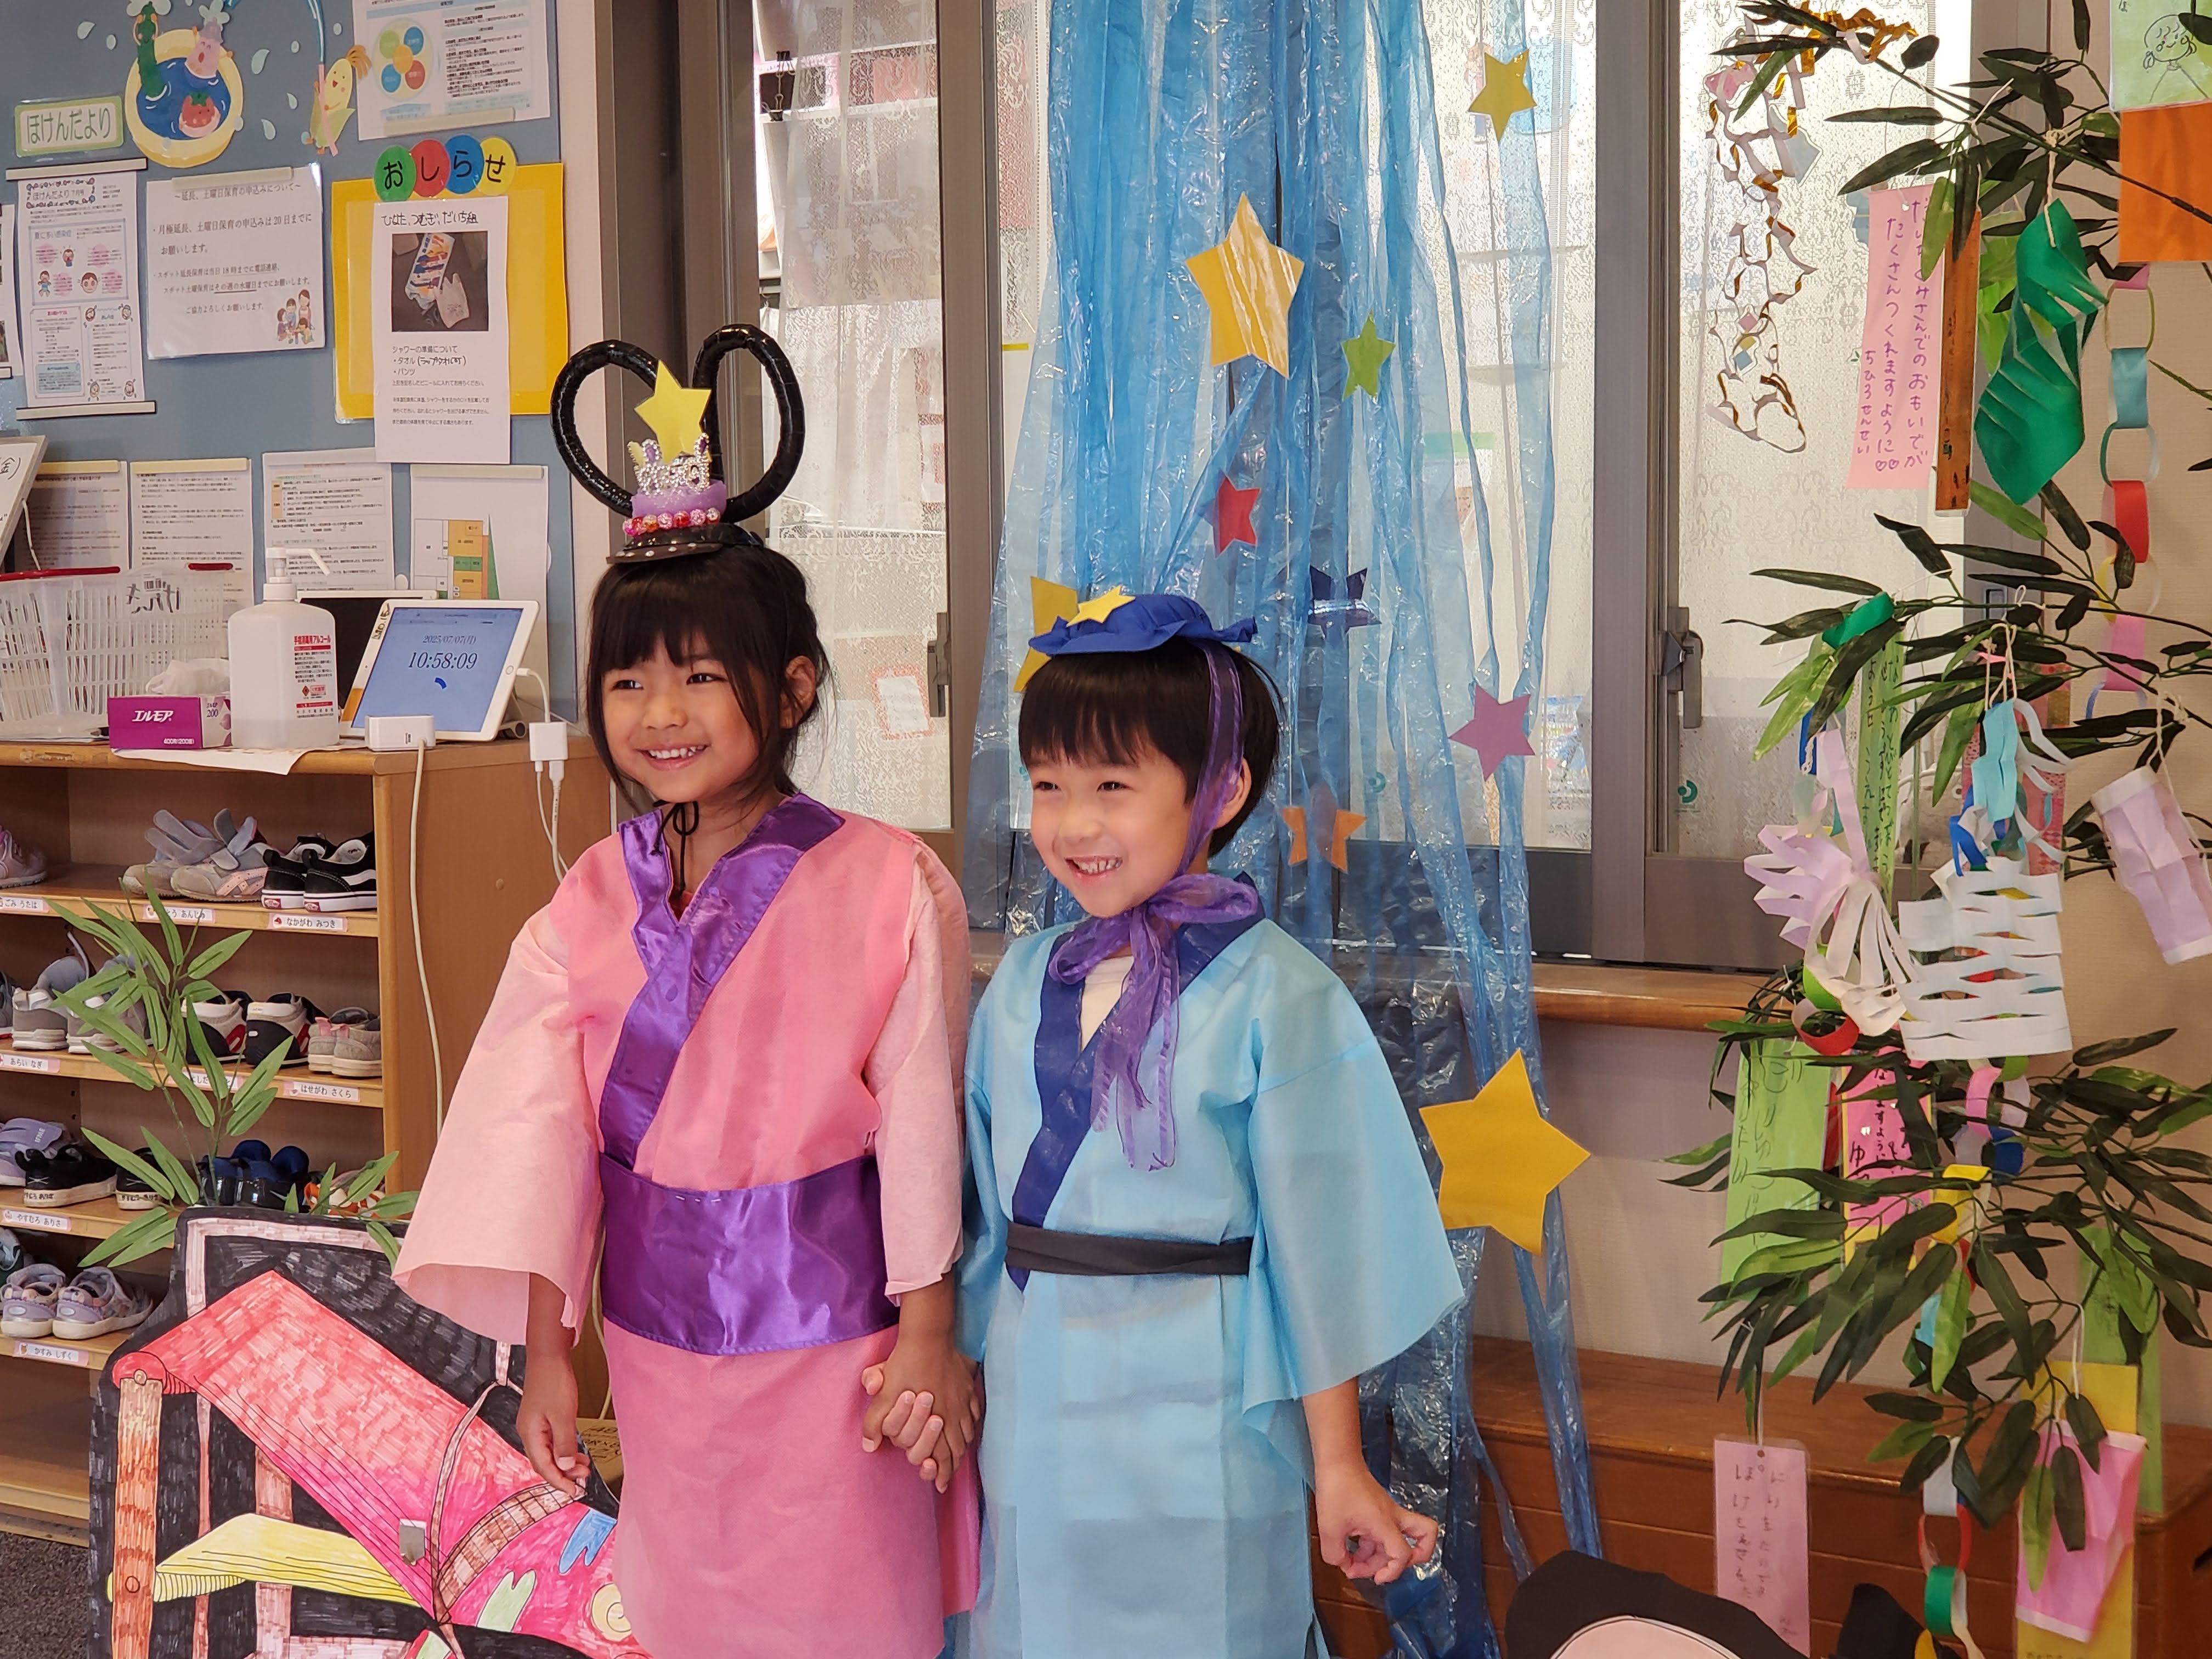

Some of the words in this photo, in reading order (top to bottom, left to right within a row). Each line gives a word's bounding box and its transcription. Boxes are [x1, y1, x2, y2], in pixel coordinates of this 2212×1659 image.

[27, 106, 111, 144] ほけんだより
[384, 149, 506, 189] おしらせ
[1858, 350, 1876, 454] ちひろせんせい
[408, 652, 478, 669] 10:58:09
[207, 709, 218, 717] 200
[286, 917, 313, 927] なかがわ
[316, 919, 336, 928] みつき
[301, 1085, 328, 1095] はせがわ
[331, 1089, 352, 1098] さくら
[17, 1214, 40, 1224] やすむろ
[44, 1218, 61, 1227] ありさ
